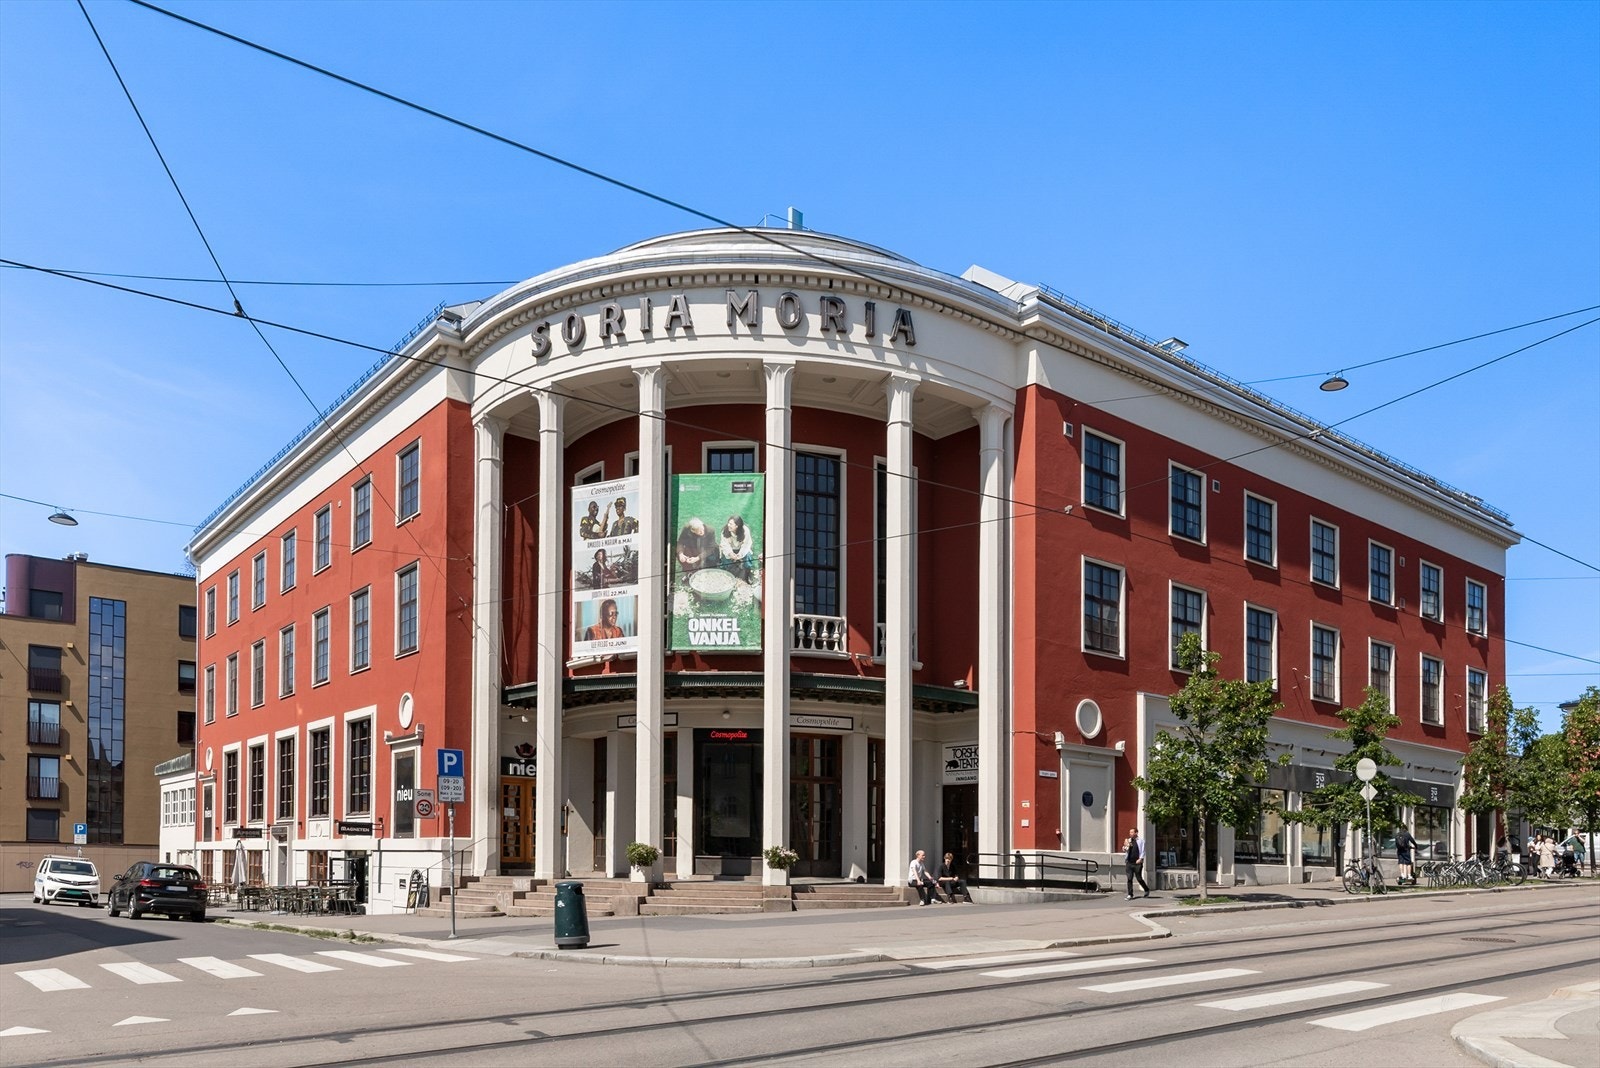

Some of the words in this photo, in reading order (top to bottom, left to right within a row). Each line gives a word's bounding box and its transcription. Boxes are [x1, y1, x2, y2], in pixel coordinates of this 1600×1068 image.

[531, 293, 693, 358] SORIA
[725, 289, 917, 346] MORIA
[591, 483, 626, 496] Cosmopolite
[688, 618, 741, 632] ONKEL
[688, 631, 741, 646] VANJA
[796, 716, 840, 727] Cosmopolite
[711, 730, 748, 740] Cosmopolite
[443, 752, 458, 774] P
[396, 785, 413, 802] nieu
[419, 803, 430, 812] 30
[77, 825, 84, 834] P
